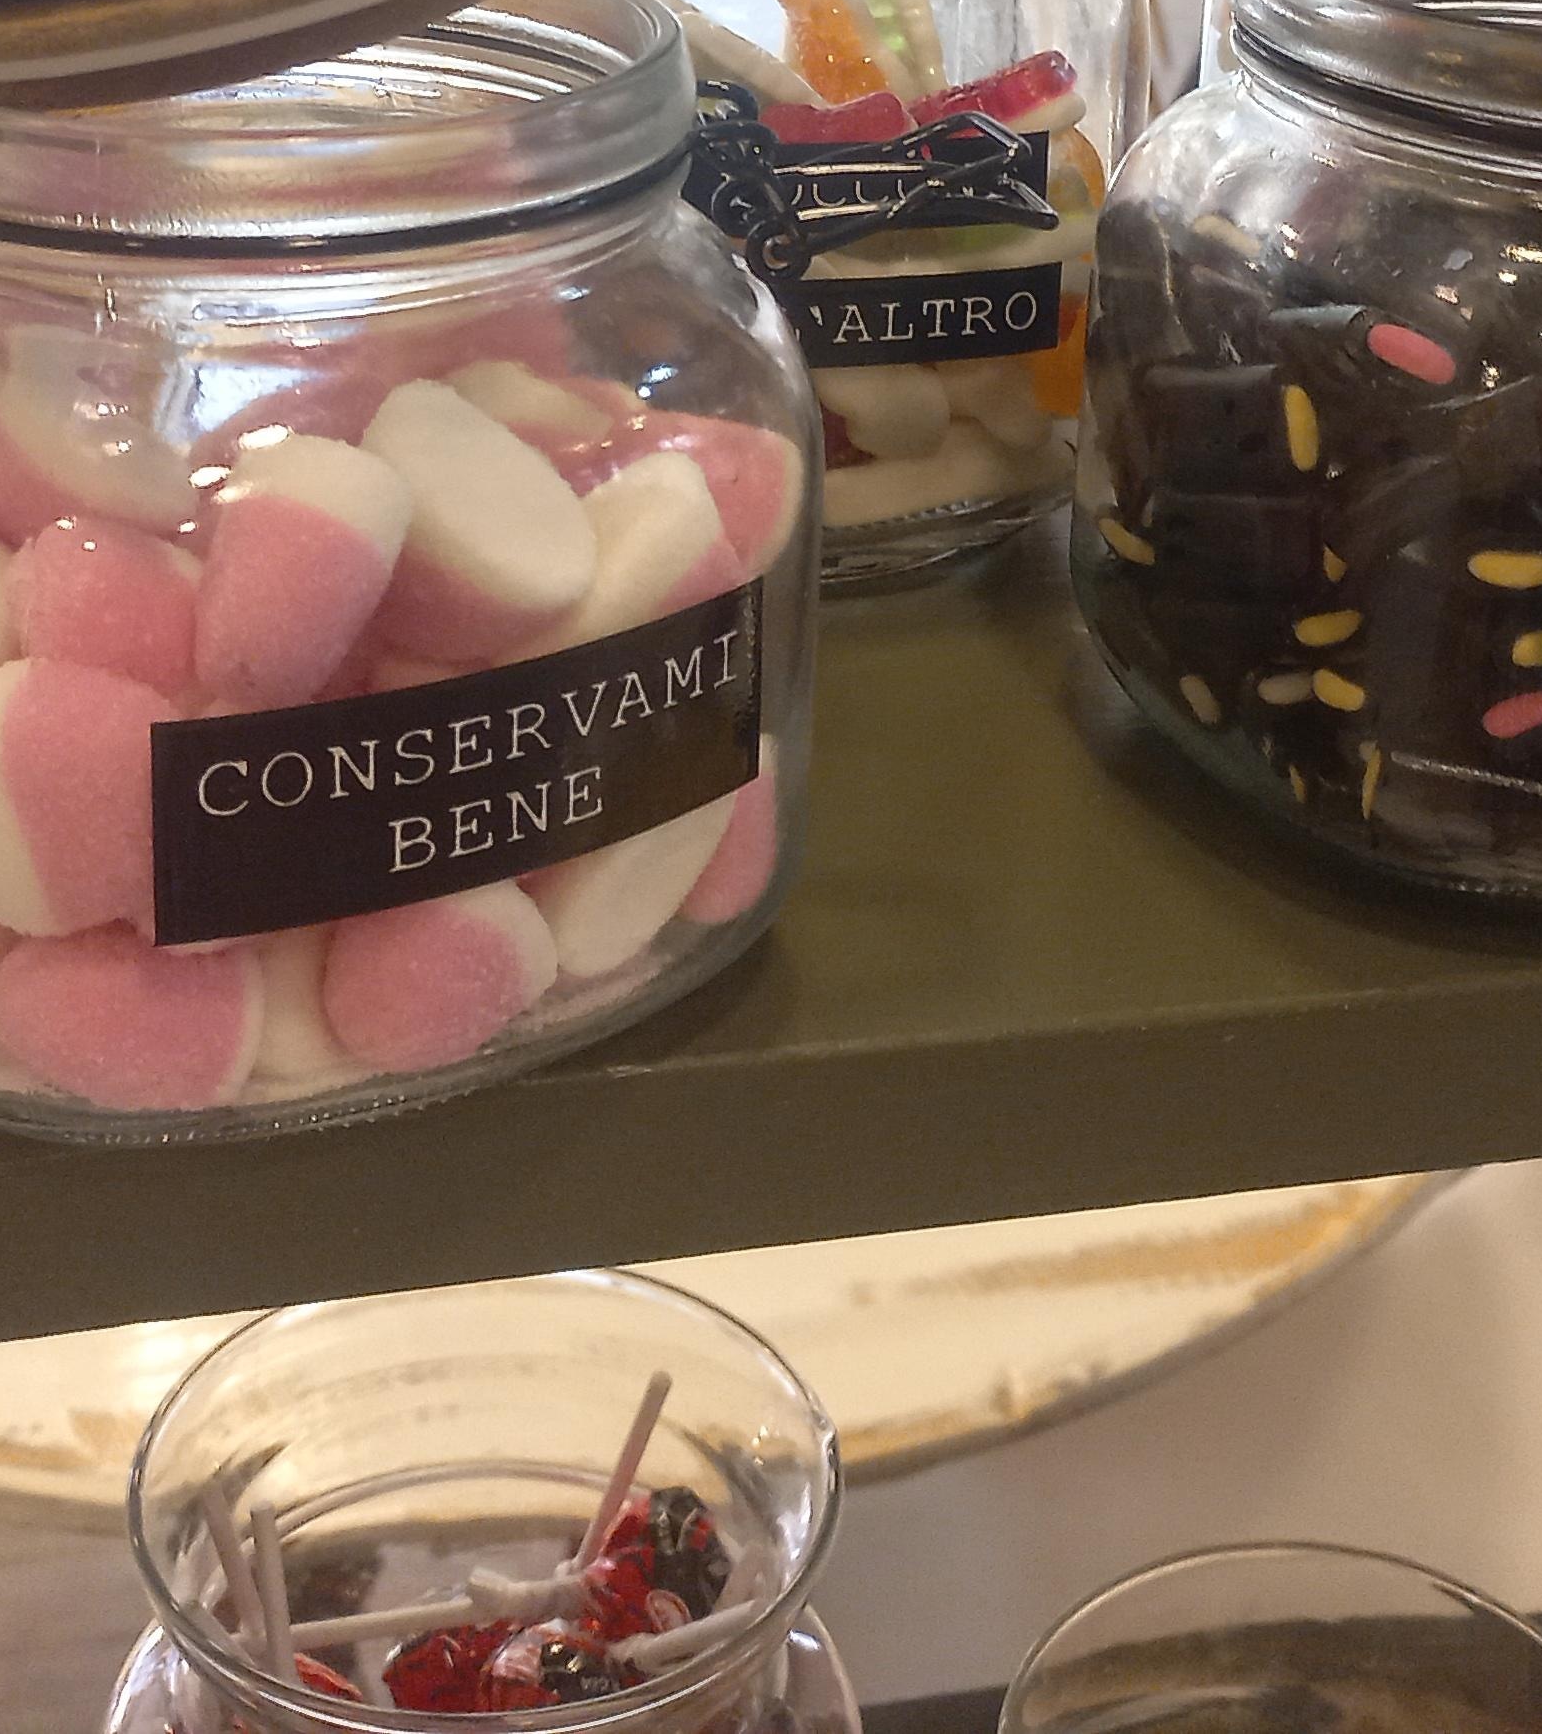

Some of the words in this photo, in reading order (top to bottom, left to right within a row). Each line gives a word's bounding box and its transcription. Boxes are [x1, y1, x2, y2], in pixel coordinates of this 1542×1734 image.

[794, 290, 1037, 344] 'ALTRO
[197, 630, 739, 817] CONSERVAMI
[388, 765, 604, 874] BENE
